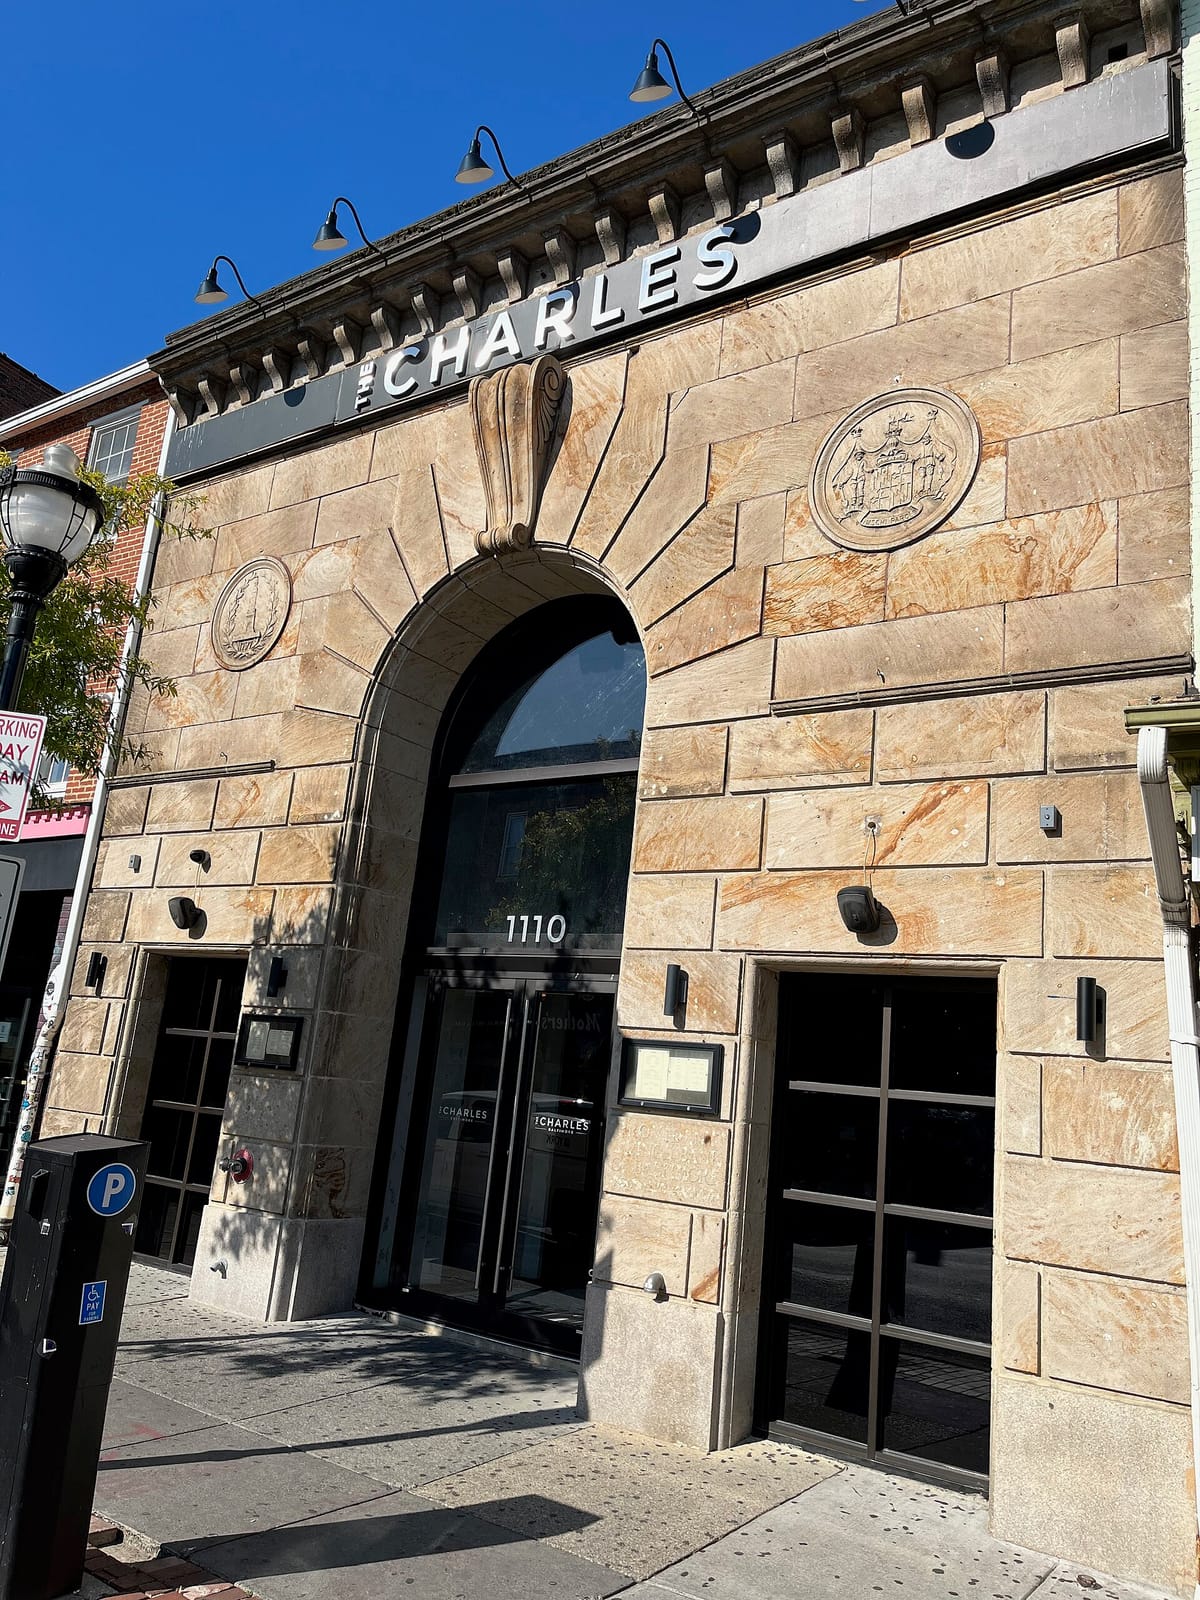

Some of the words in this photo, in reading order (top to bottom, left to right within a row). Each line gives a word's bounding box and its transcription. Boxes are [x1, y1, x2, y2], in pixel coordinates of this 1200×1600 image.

[354, 361, 376, 410] THE
[383, 225, 737, 397] CHARLES
[506, 914, 566, 943] 1110
[443, 1106, 487, 1119] CHARLES
[539, 1117, 589, 1131] CHARLES
[102, 1173, 125, 1207] P
[86, 1301, 99, 1311] PAY
